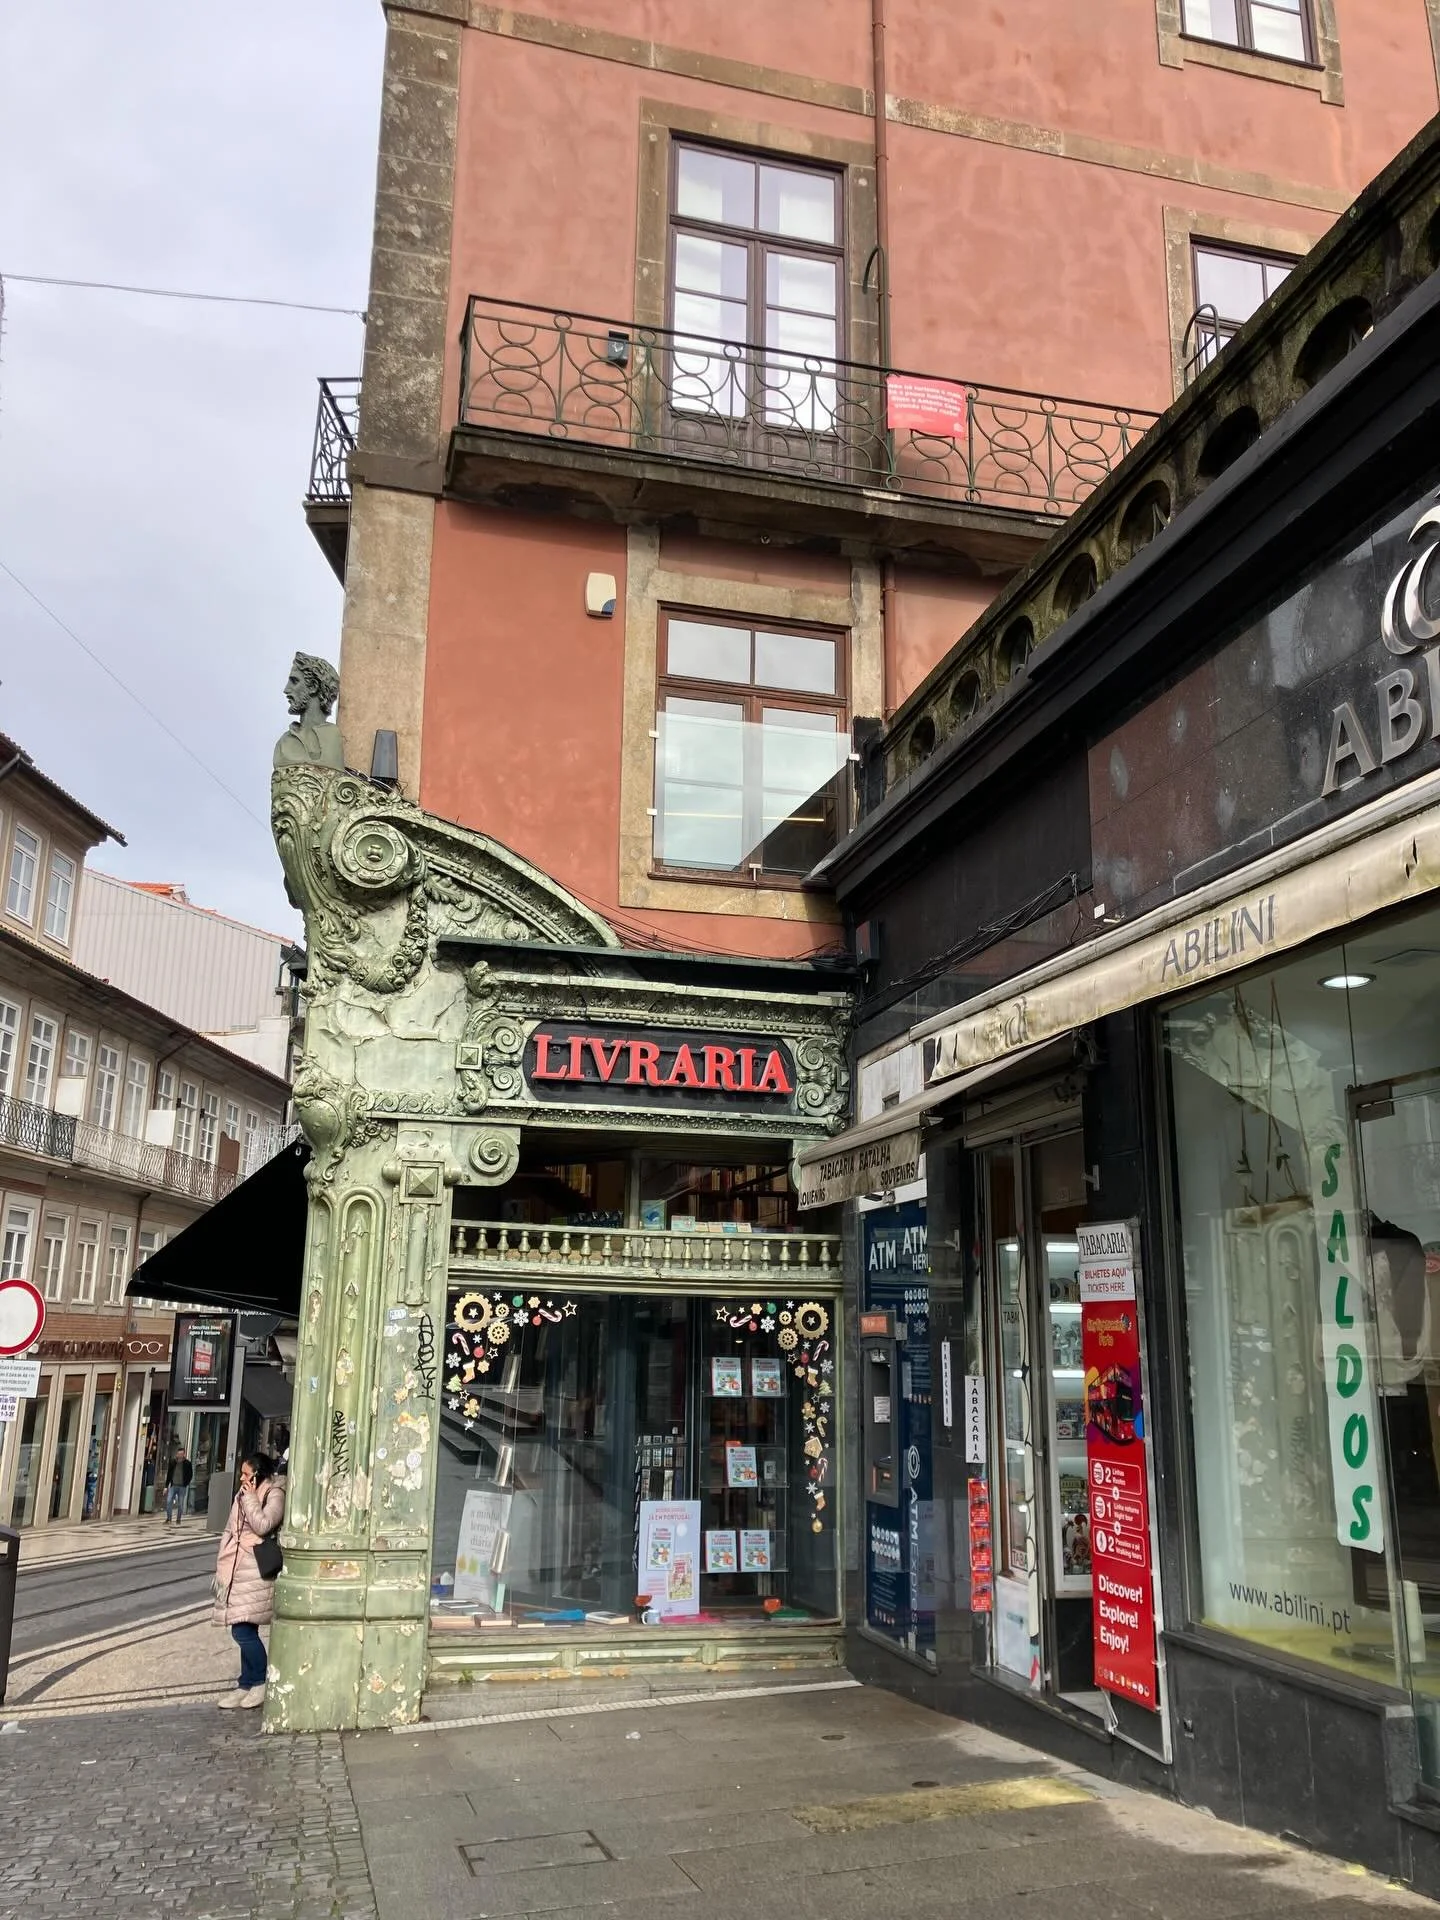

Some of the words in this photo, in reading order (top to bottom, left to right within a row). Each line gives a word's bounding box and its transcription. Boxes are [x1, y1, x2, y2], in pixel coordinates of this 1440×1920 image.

[1161, 894, 1275, 983] ABILINI
[531, 1034, 794, 1093] LIVRARIA
[819, 1154, 855, 1183] TABACARIA
[859, 1143, 891, 1171] BATALHA
[869, 1239, 897, 1271] ATM
[902, 1225, 928, 1256] ATM
[1079, 1231, 1127, 1256] TABACARIA
[1085, 1268, 1111, 1280] BILHETES
[1112, 1266, 1127, 1280] AQUI
[1087, 1283, 1109, 1293] TICKETS
[1110, 1281, 1126, 1292] HERE
[1321, 1144, 1373, 1542] SALDOS
[971, 1378, 980, 1461] TABACARIA
[1105, 1467, 1112, 1484] 2
[1106, 1501, 1112, 1518] 1
[1108, 1535, 1115, 1553] 2
[1098, 1573, 1143, 1605] Discover!
[1099, 1599, 1139, 1629] Explore!
[1229, 1582, 1352, 1636] www.abilini.pt
[1100, 1625, 1130, 1655] Enjoy!
